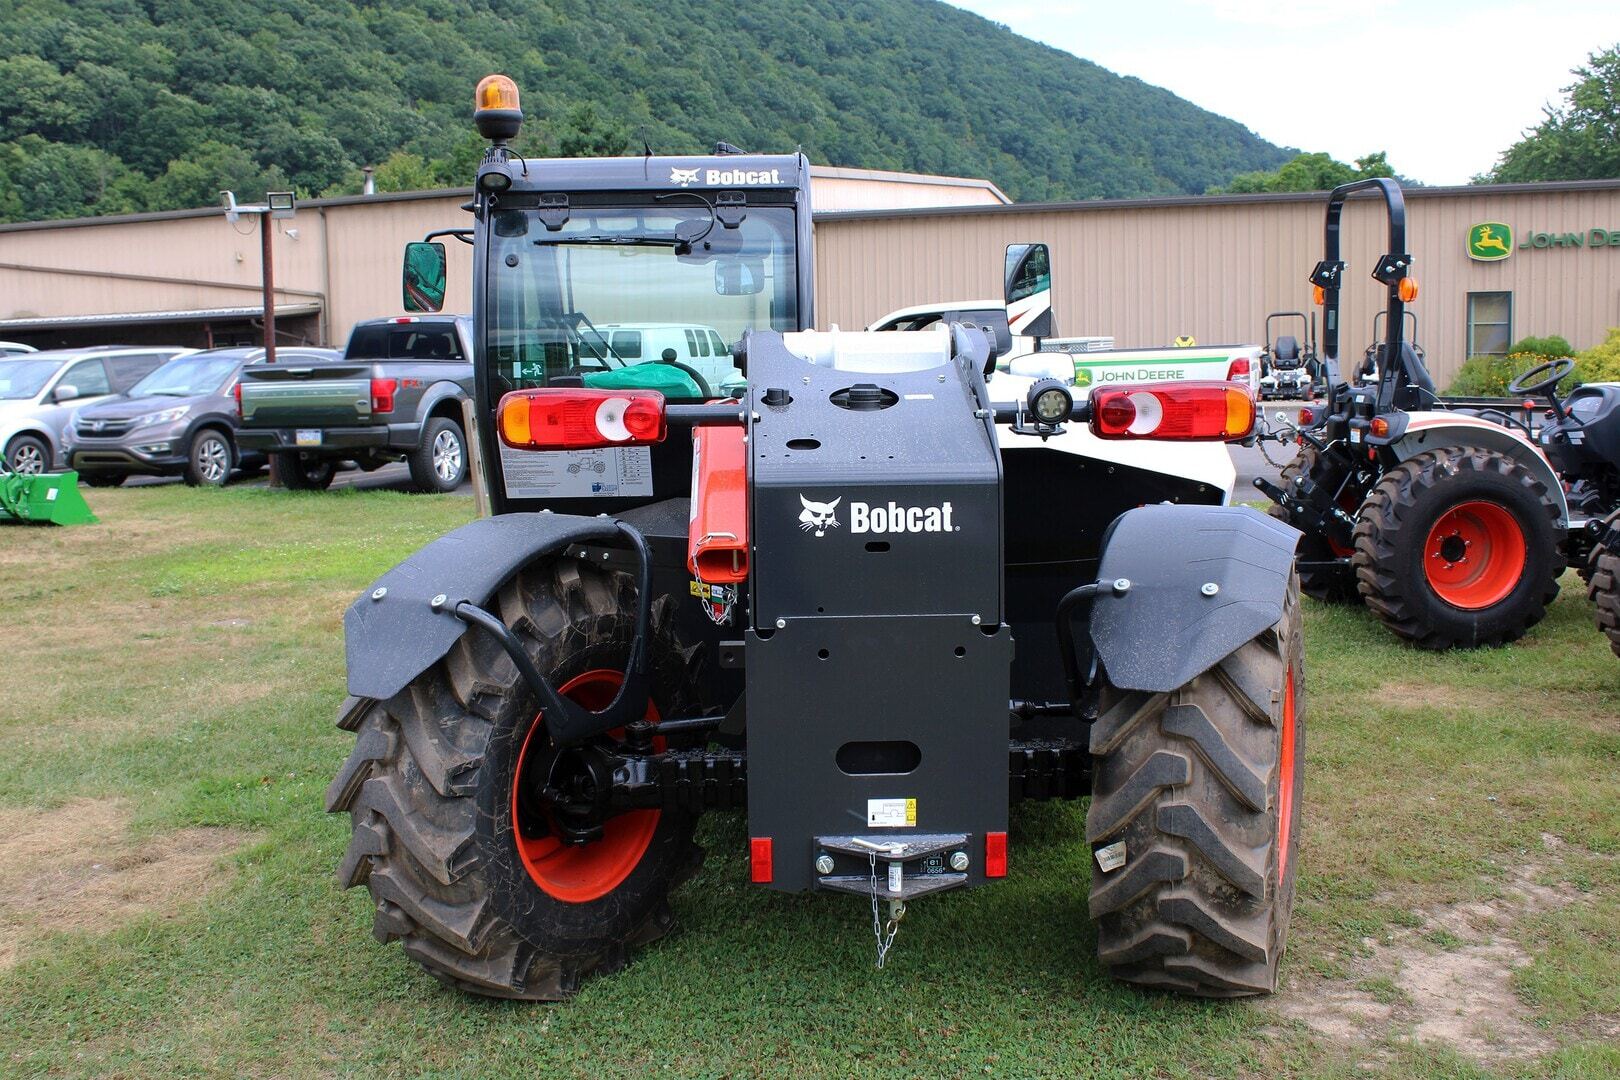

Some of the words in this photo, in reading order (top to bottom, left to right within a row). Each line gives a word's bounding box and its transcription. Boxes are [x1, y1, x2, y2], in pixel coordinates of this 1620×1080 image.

[706, 169, 780, 186] Bobcat
[1519, 230, 1584, 249] JOHN
[1097, 370, 1135, 382] JOHN
[1137, 369, 1185, 381] DEERE
[850, 501, 953, 534] Bobcat
